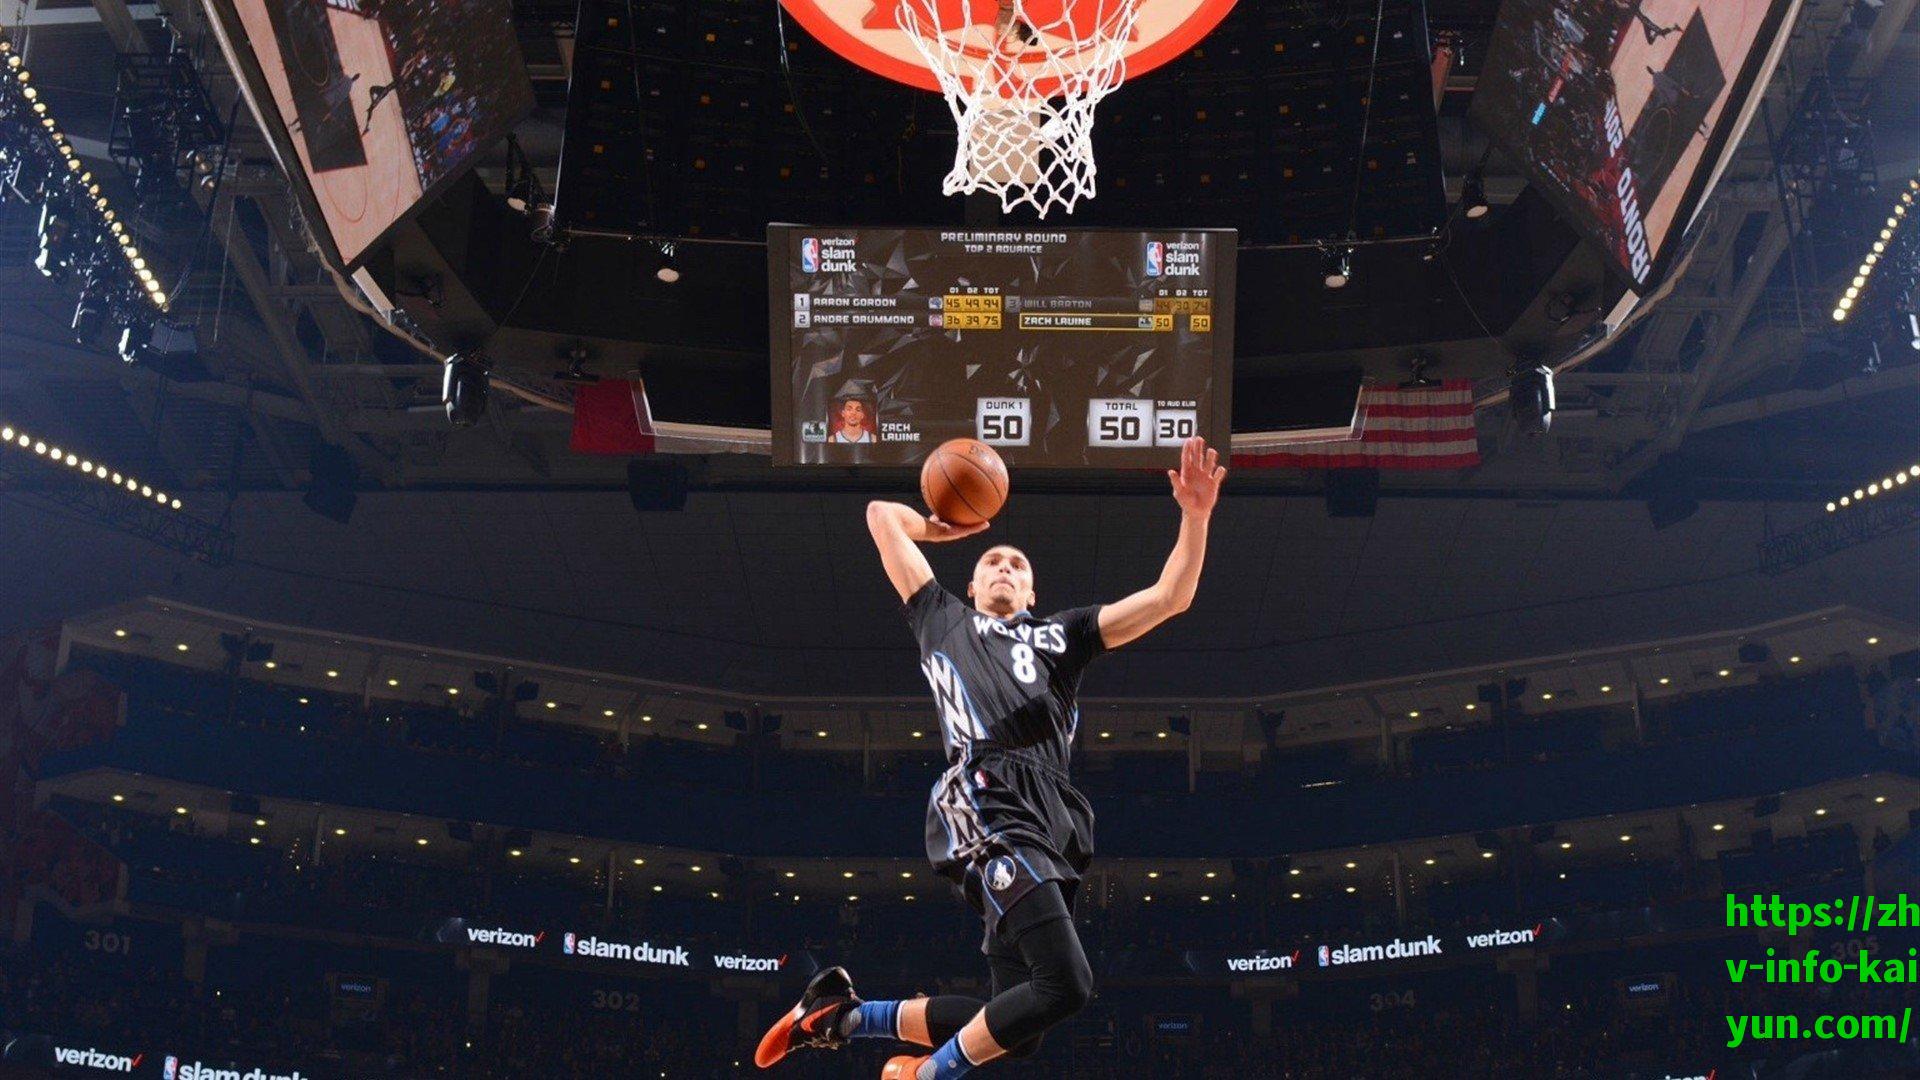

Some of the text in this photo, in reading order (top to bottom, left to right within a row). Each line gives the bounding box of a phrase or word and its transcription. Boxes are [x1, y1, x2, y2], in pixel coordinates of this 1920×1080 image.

[1617, 167, 1651, 284] RONTO
[821, 237, 855, 246] verizon
[941, 232, 1067, 243] PRELIMINARY ROUND
[965, 245, 1042, 254] TOP 2 ADVANCE
[1165, 241, 1200, 250] verizon
[821, 246, 856, 259] slam
[1165, 250, 1200, 263] slam
[821, 259, 857, 272] dunk
[1164, 262, 1200, 276] dunk
[813, 298, 850, 307] AARON
[852, 298, 897, 307] GORDON
[946, 298, 960, 308] 45
[965, 298, 980, 308] 49
[983, 298, 999, 308] 94
[1024, 299, 1047, 309] WILL
[798, 315, 806, 324] 2
[813, 315, 850, 324] ANDRE
[852, 315, 915, 325] DRUMMOND
[966, 316, 980, 326] 39
[983, 316, 999, 326] 75
[1024, 317, 1209, 328] ZACH LAVINE 50 50
[986, 401, 1015, 410] DUNK
[1105, 402, 1138, 411] TOTAL
[881, 423, 911, 432] ZACH
[982, 415, 1023, 440] 50
[1100, 416, 1140, 441] 50
[1159, 418, 1193, 438] 30
[881, 432, 920, 442] LAVINE
[1011, 643, 1037, 683] 8
[467, 927, 536, 948] verizon
[1466, 929, 1534, 948] verizon
[577, 936, 689, 966] slam dunk
[1331, 935, 1443, 966] slam dunk
[714, 954, 779, 971] verizon
[1227, 955, 1293, 971] verizon
[55, 1046, 132, 1073] verizon
